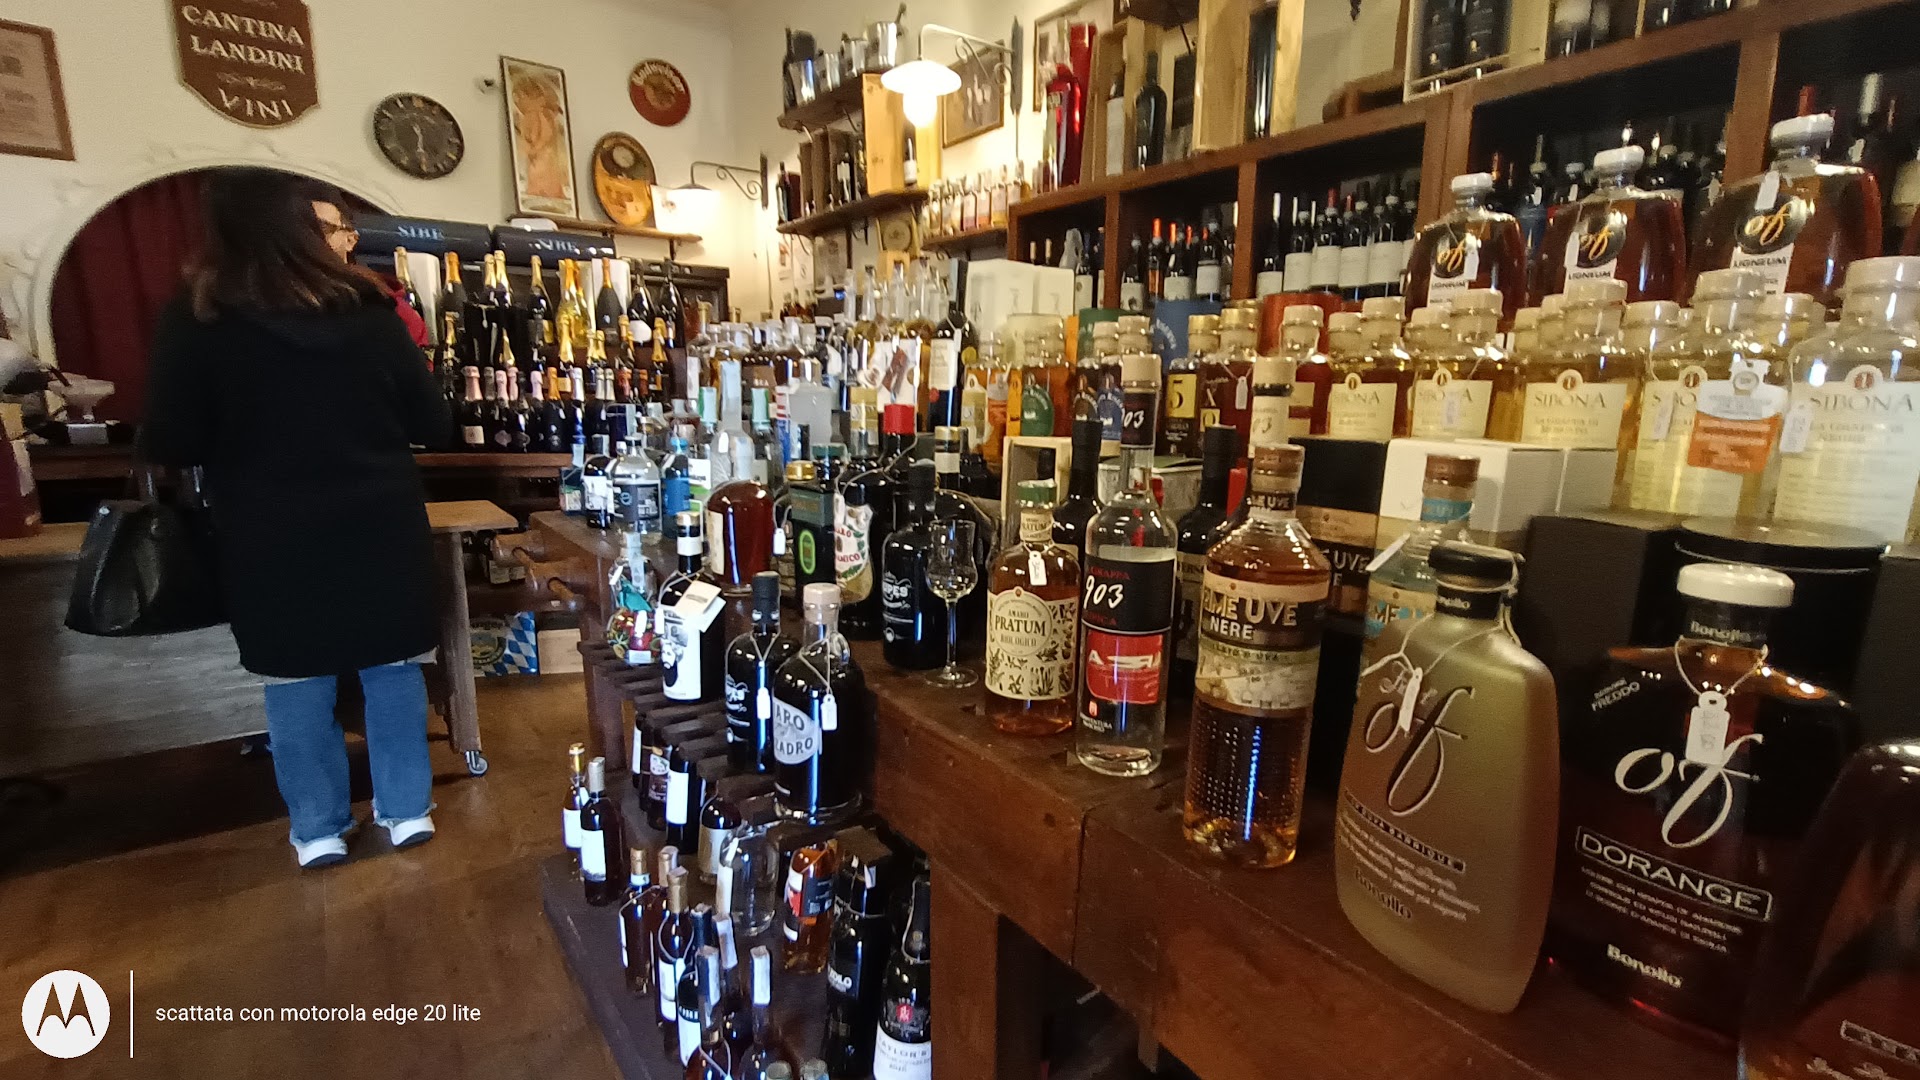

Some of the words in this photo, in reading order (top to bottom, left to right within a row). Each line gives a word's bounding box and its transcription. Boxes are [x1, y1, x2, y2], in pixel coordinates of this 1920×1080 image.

[181, 5, 305, 47] CANTINA
[190, 34, 305, 75] LANDINI
[218, 87, 293, 121] VINI
[1534, 391, 1607, 409] SIBONA
[1810, 393, 1913, 412] SIBONA
[1083, 574, 1124, 610] 903
[994, 614, 1046, 637] PRATUM
[1008, 609, 1029, 619] AMARO
[1245, 596, 1299, 626] UVE
[1210, 615, 1254, 640] NERE
[1591, 681, 1641, 712] FREDDO
[1581, 833, 1762, 916] DORANGE
[1606, 943, 1684, 989] Bonollo
